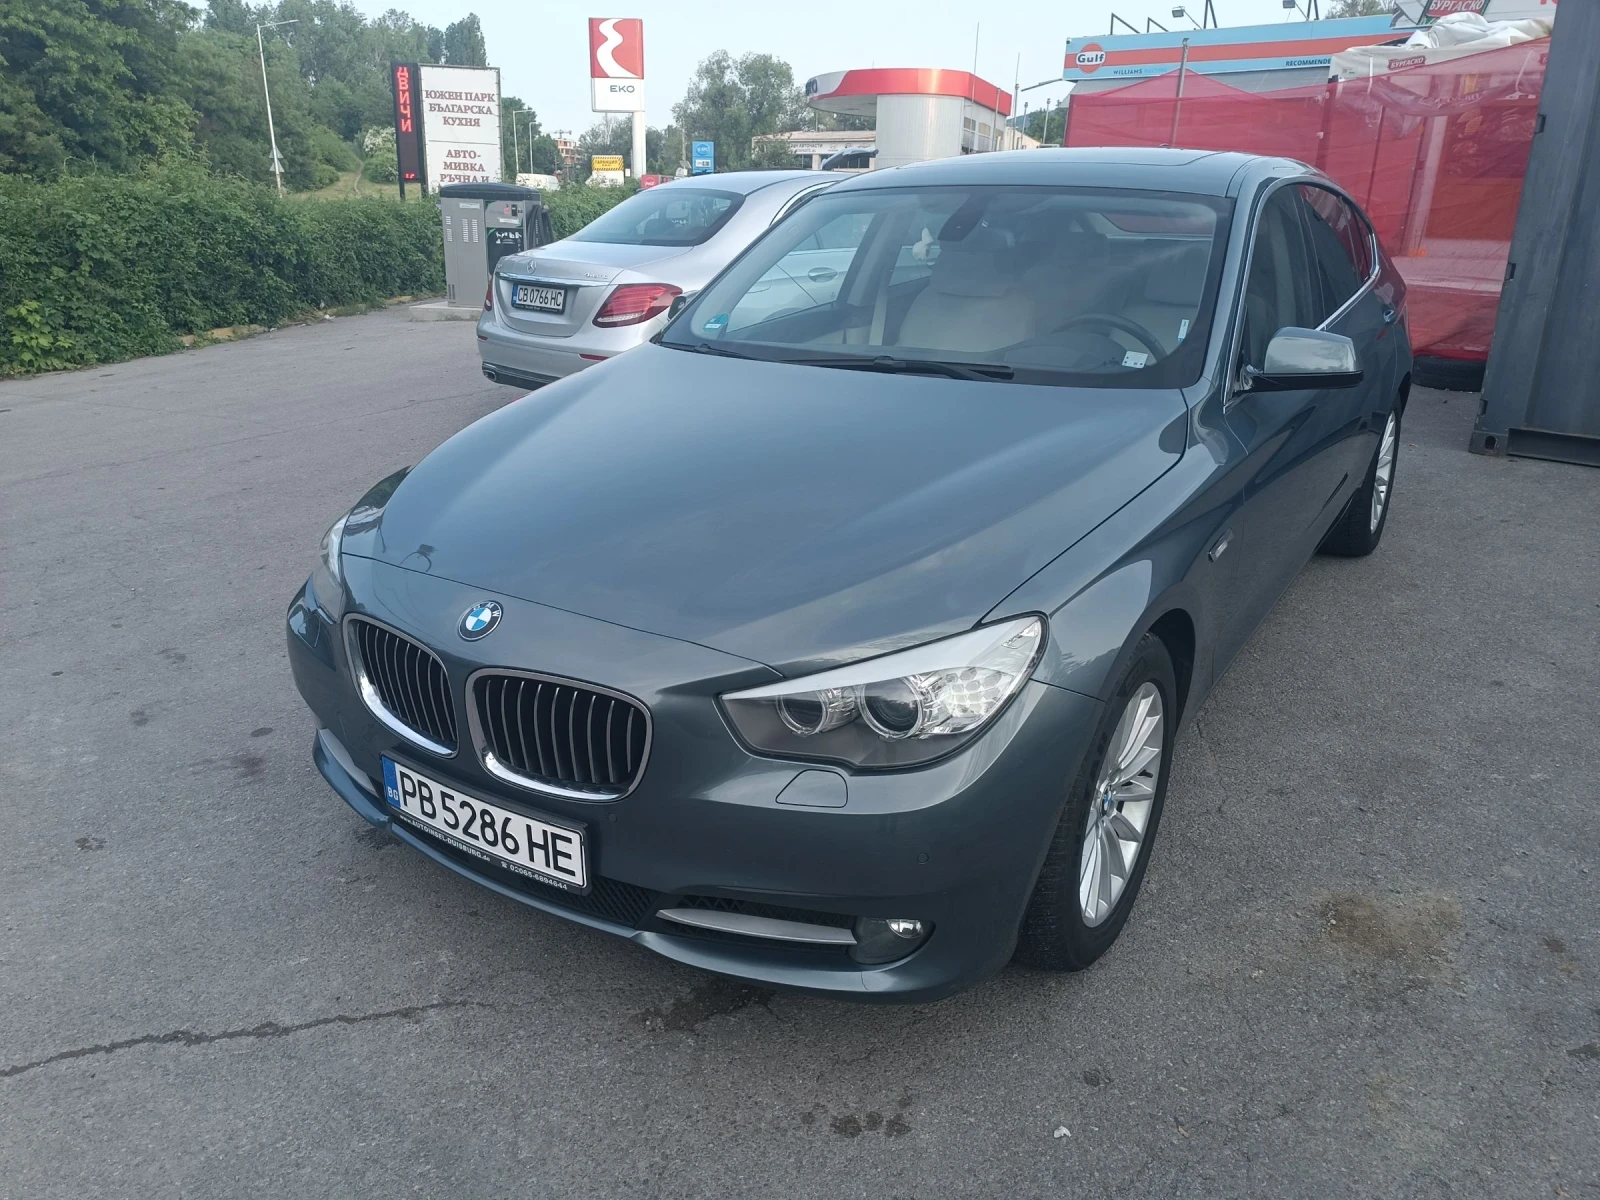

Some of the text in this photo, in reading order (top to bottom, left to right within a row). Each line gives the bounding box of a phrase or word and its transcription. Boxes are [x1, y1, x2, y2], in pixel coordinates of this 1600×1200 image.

[1429, 0, 1484, 11] БУРГАСКО
[1077, 53, 1104, 63] Gulf
[1390, 57, 1424, 69] БУРГАСКО
[609, 84, 635, 94] EKO
[424, 89, 496, 103] ЮЖЕН ПАРК
[428, 102, 494, 115] БЪЛГАРСКА
[442, 116, 481, 127] КУХНЯ
[446, 149, 482, 159] АВТО-
[443, 161, 486, 172] МИВКА
[439, 173, 479, 183] РЪЧНА
[517, 287, 563, 307] CB 0766 HC
[387, 786, 399, 801] BG
[398, 770, 576, 878] PB 5286 HE
